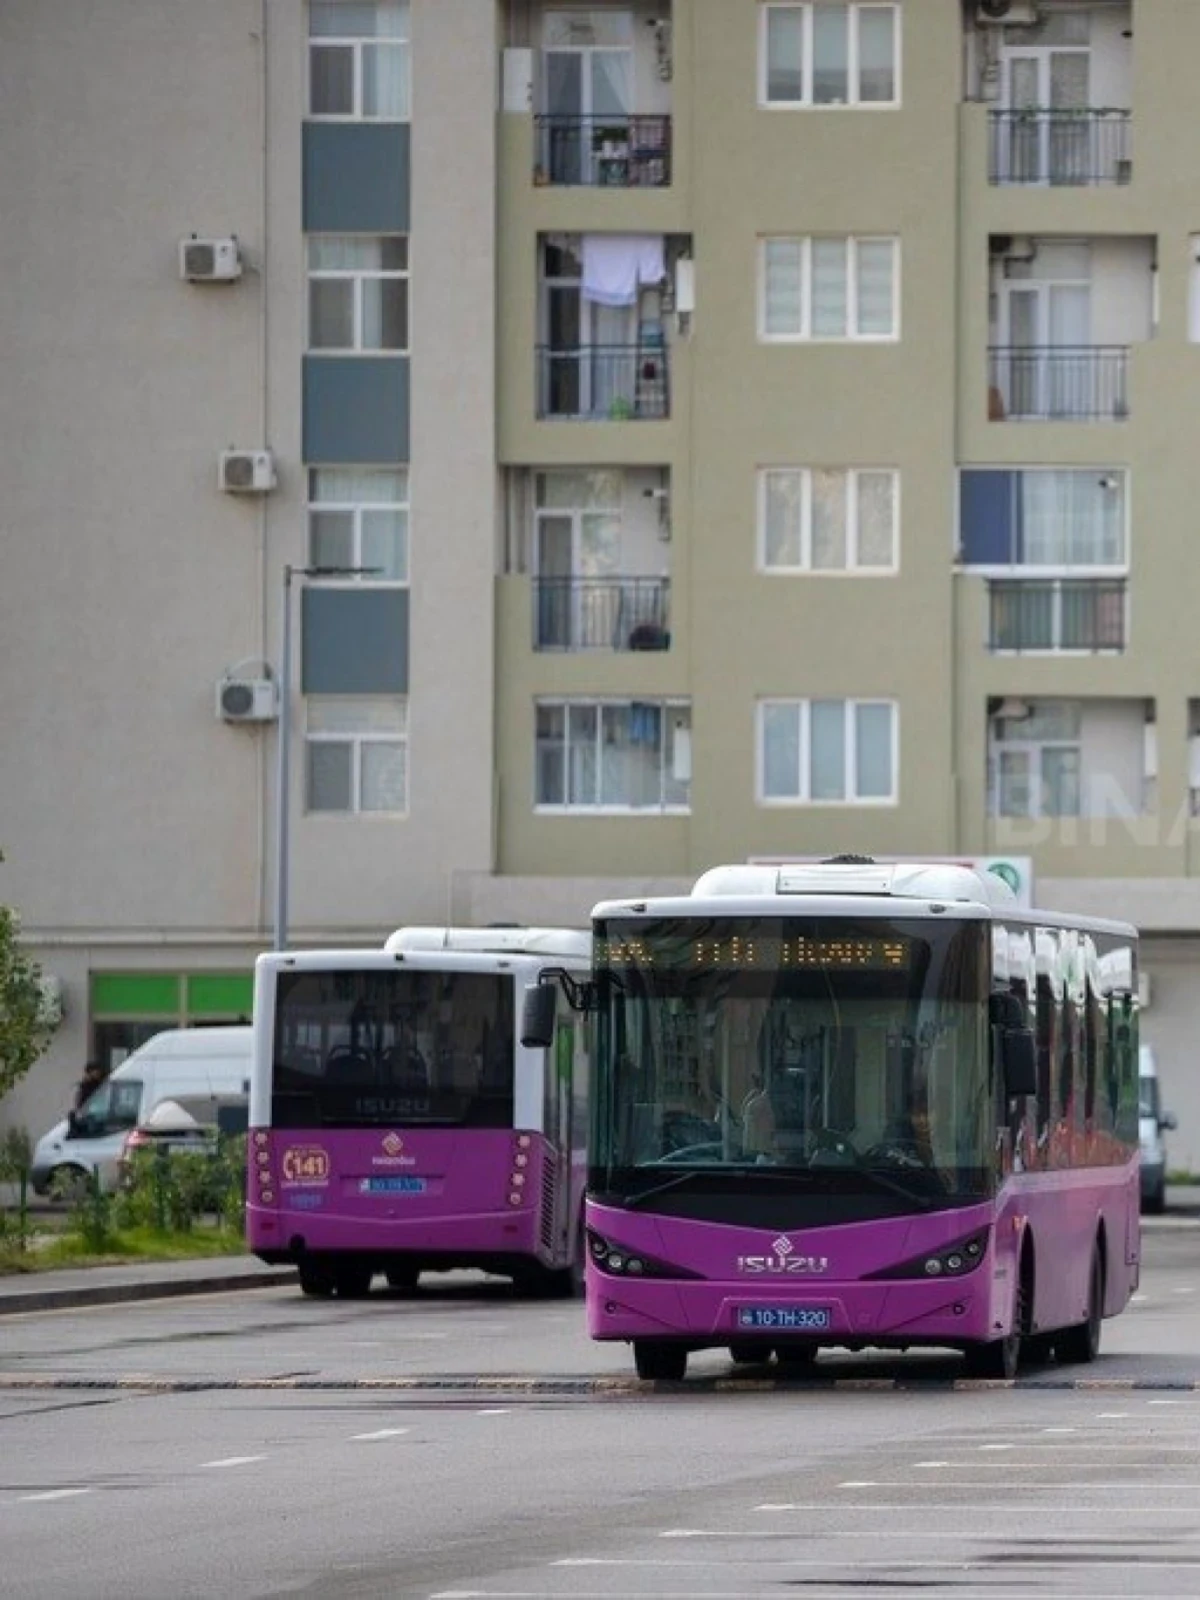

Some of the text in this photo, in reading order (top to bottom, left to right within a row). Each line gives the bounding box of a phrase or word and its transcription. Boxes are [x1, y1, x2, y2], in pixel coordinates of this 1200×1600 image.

[356, 1098, 431, 1113] ISUZU
[293, 1156, 325, 1175] 141
[738, 1257, 828, 1273] ISUZU
